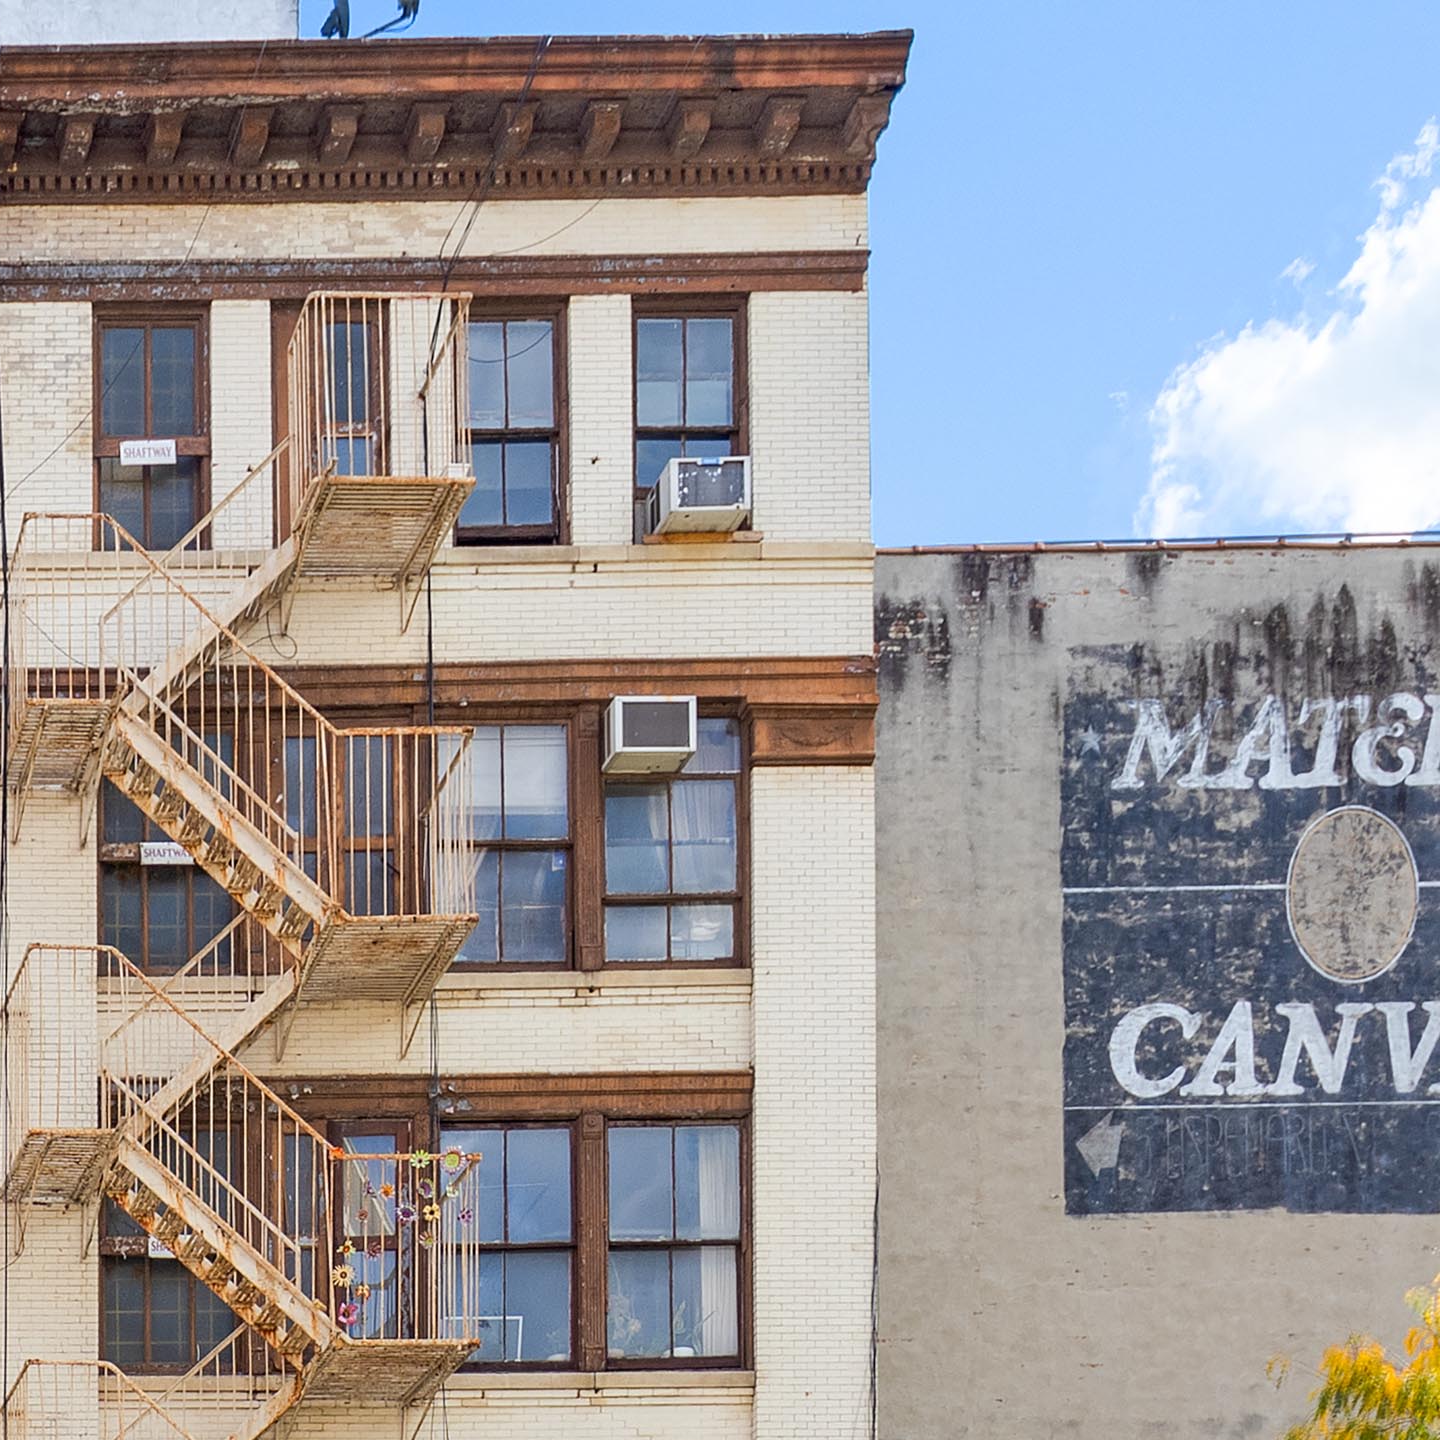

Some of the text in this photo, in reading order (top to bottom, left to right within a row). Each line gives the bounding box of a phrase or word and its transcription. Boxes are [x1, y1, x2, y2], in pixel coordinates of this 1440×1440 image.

[124, 446, 172, 458] SHAFTWAY
[144, 848, 192, 858] SHAFTWA
[1109, 999, 1440, 1097] CANV
